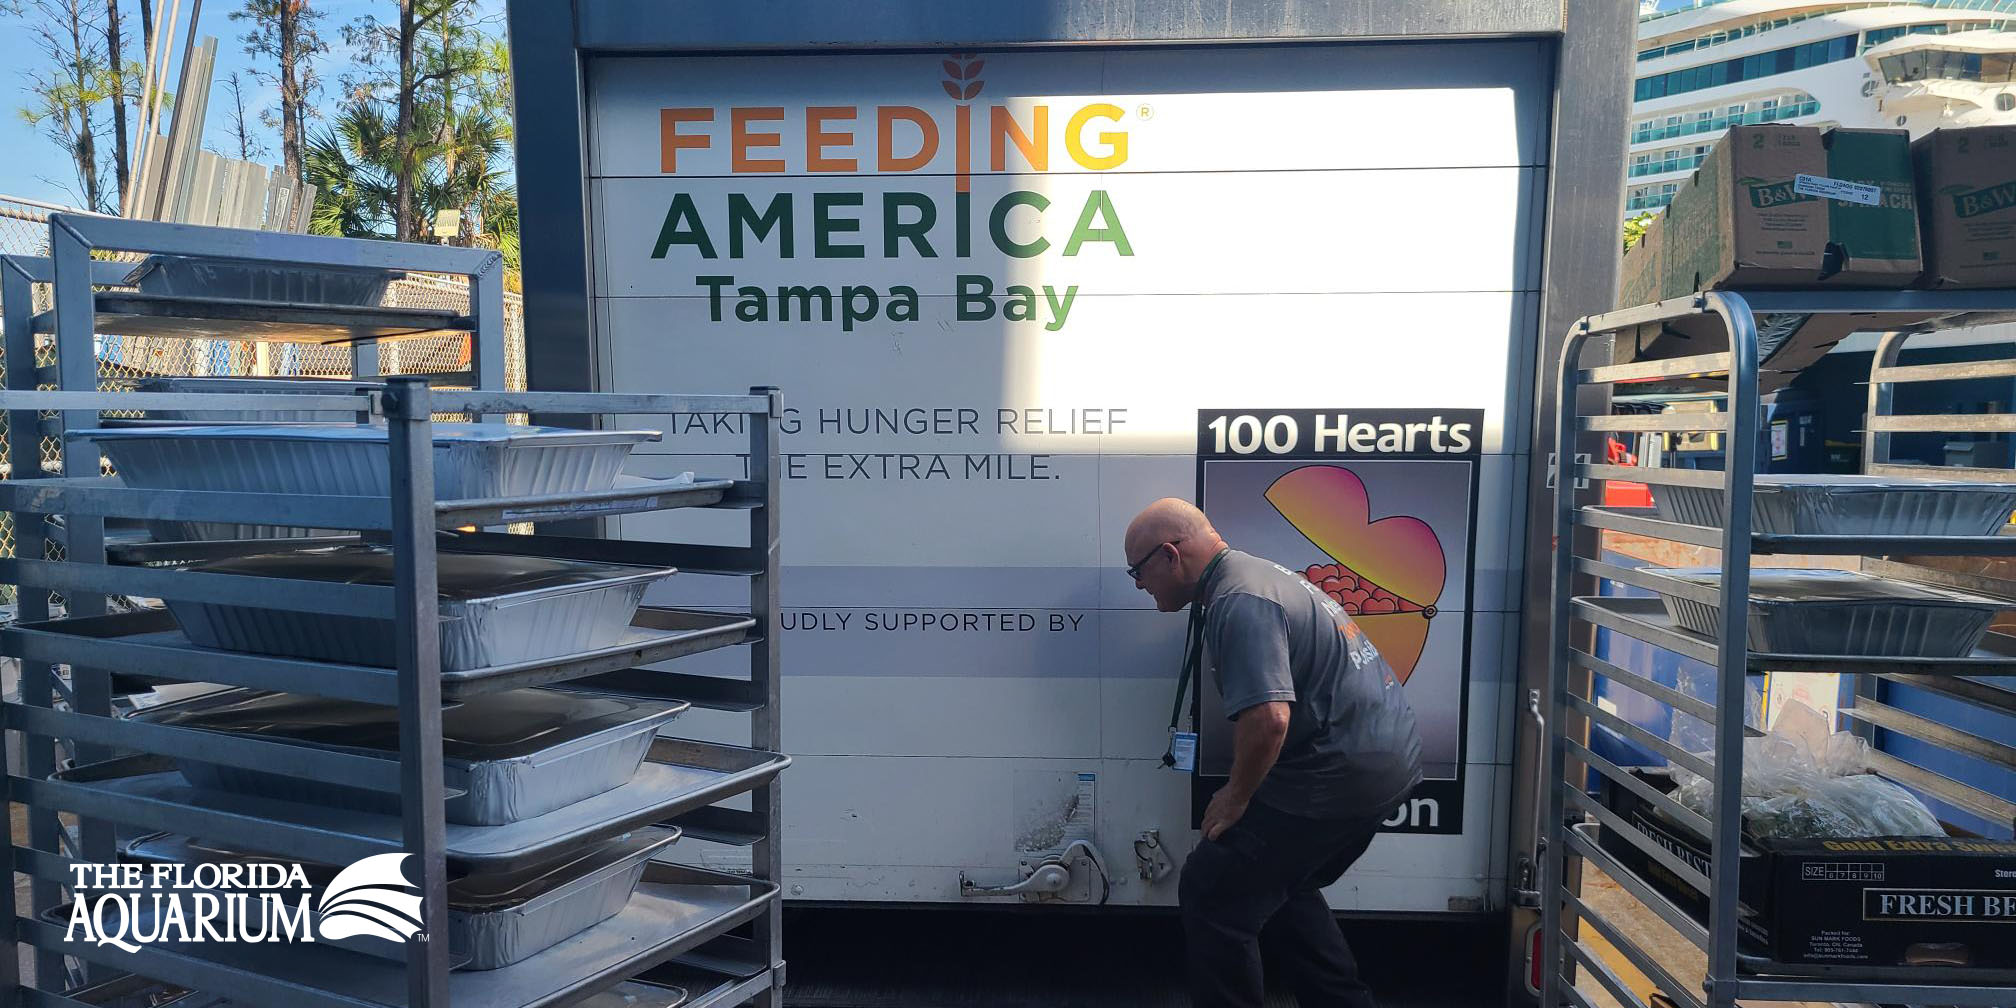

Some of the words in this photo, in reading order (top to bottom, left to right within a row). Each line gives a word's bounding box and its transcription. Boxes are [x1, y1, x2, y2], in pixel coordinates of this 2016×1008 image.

[660, 103, 1129, 176] FEEDING
[651, 189, 1135, 259] AMERICA
[696, 275, 920, 332] Tampa
[956, 274, 1079, 332] Bay
[671, 408, 802, 435] TAKIG
[819, 408, 980, 435] HUNGER
[996, 408, 1128, 435] RELIEF
[1209, 415, 1299, 454] 100
[1315, 414, 1472, 453] Hearts
[736, 454, 807, 479] TE
[824, 454, 950, 480] EXTRA
[965, 455, 1060, 480] MILE.
[780, 612, 852, 631] UDLY
[864, 613, 1036, 632] SUPPORTED
[1049, 613, 1085, 632] BY
[1823, 840, 1885, 851] Gold
[1887, 840, 1953, 851] Extra
[1804, 866, 1824, 877] SIZE
[1880, 895, 1975, 916] FRESH
[1981, 896, 2016, 917] BE
